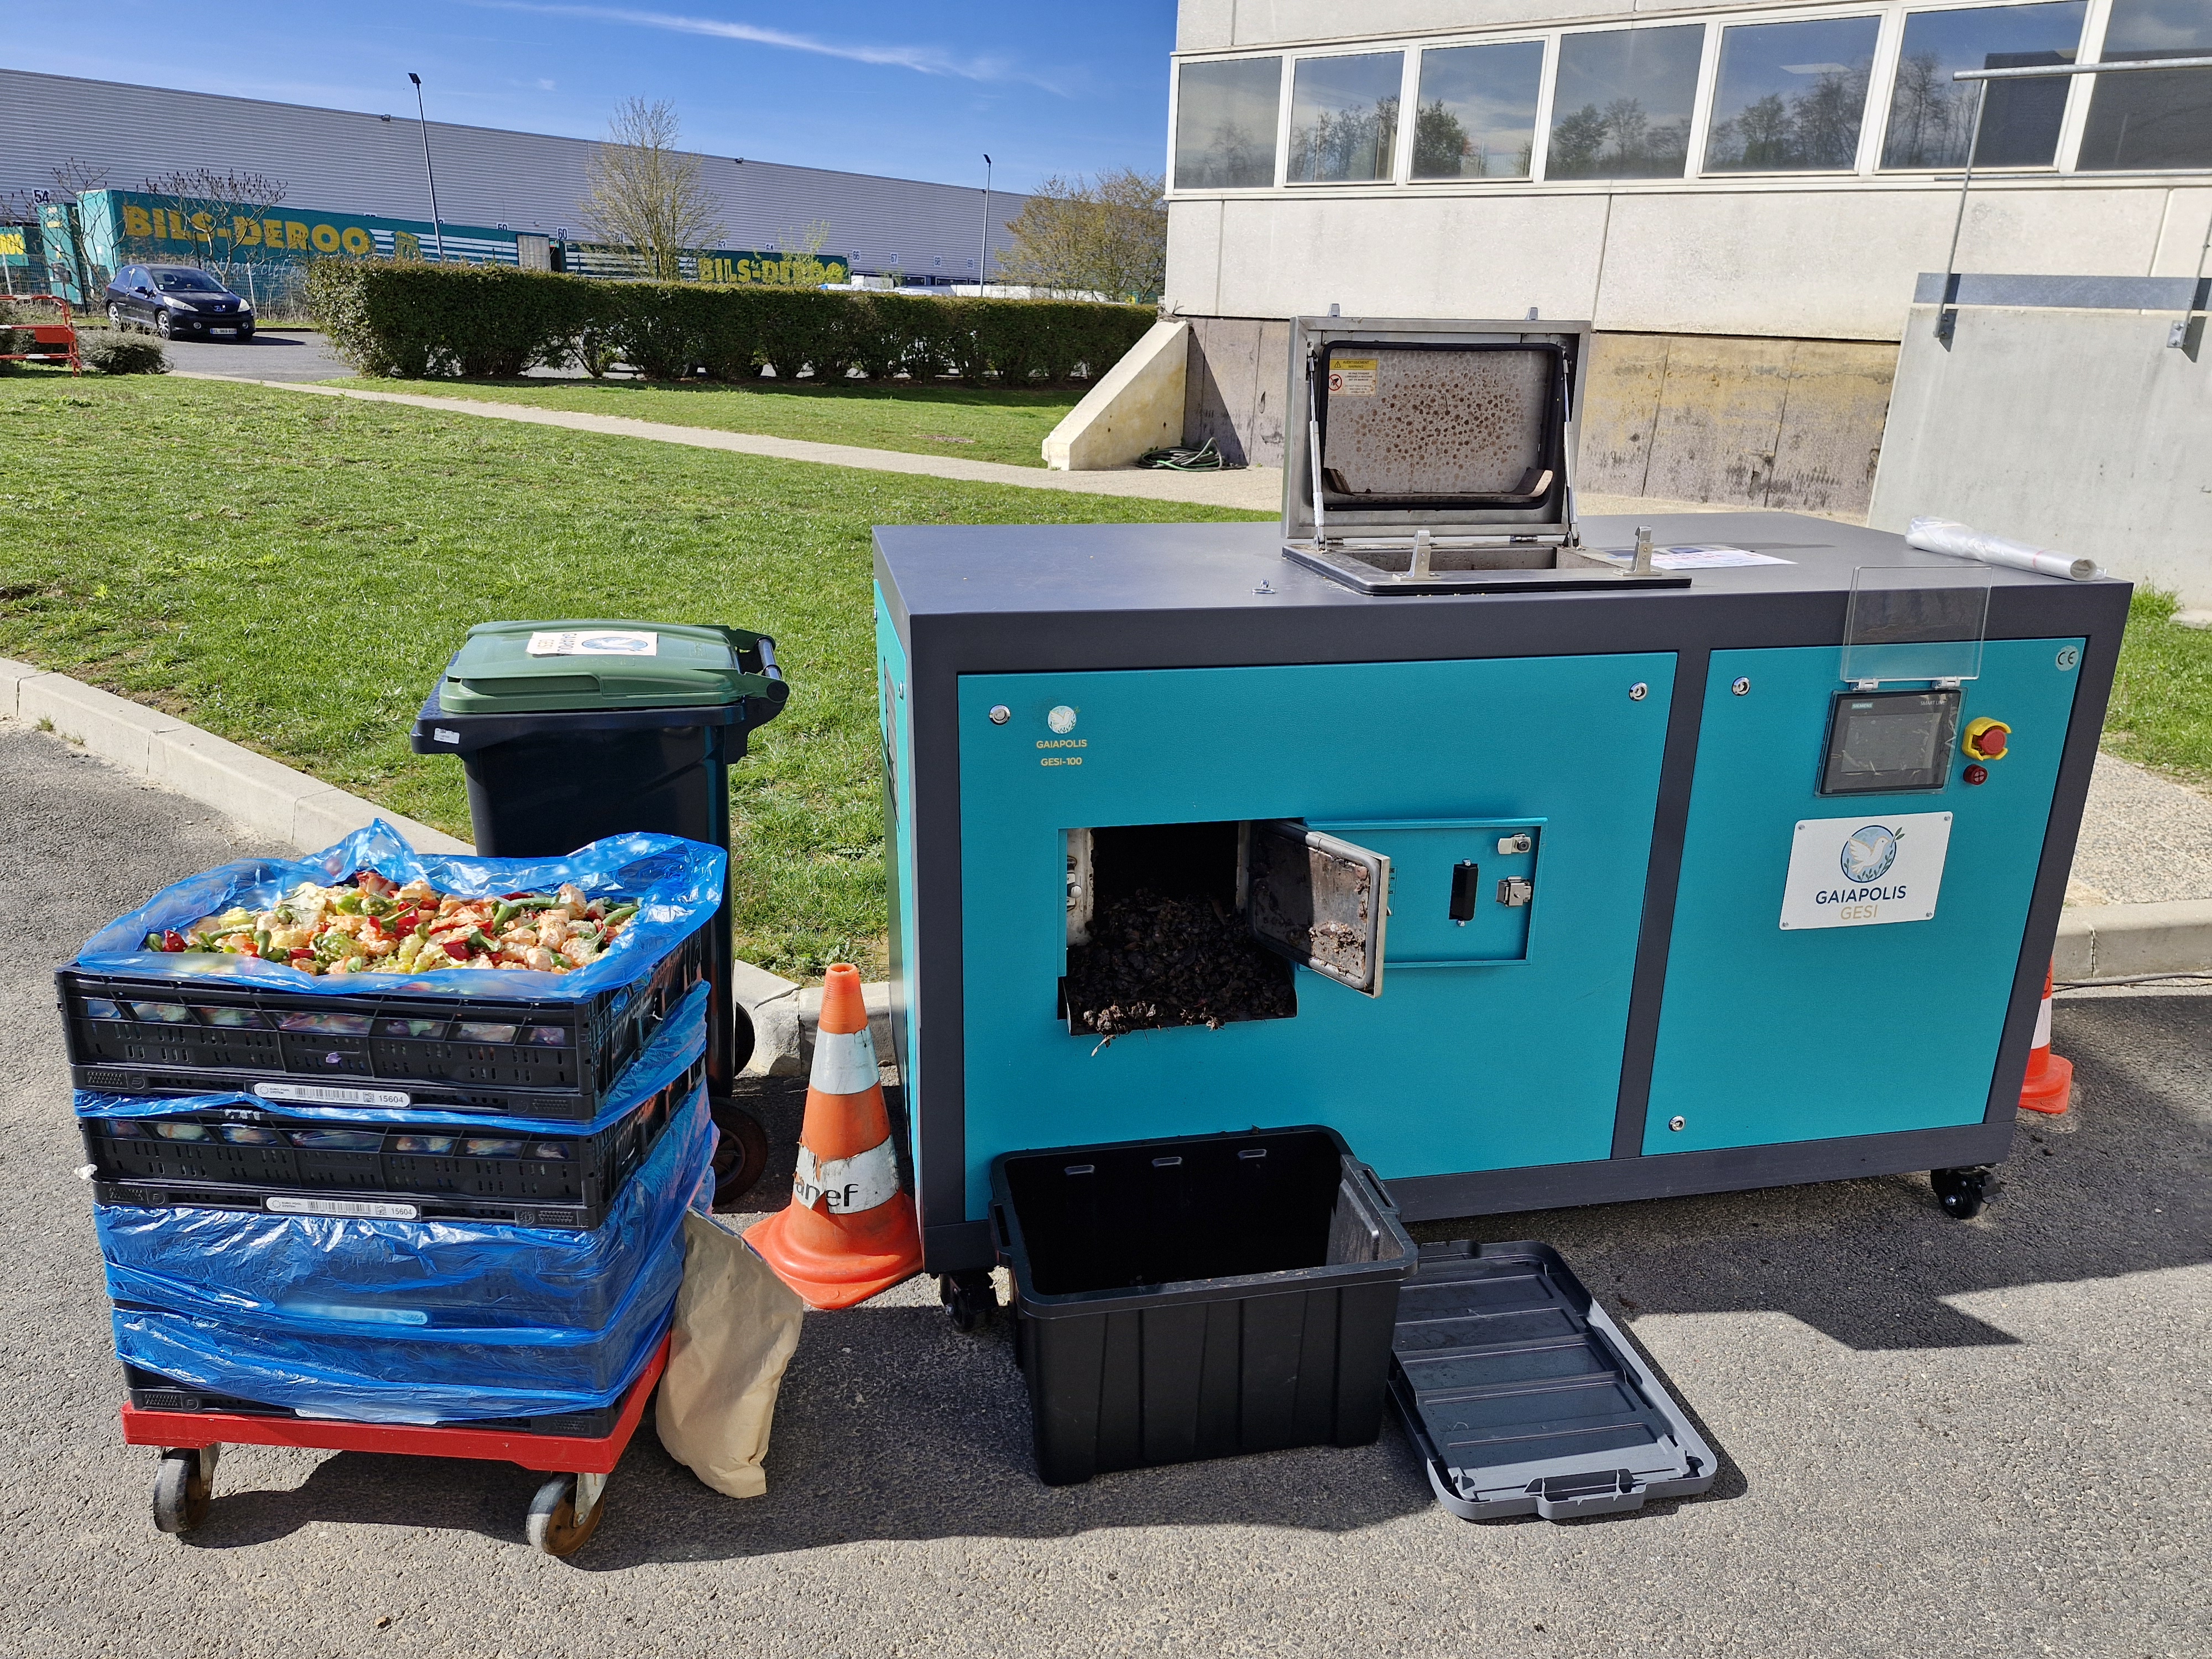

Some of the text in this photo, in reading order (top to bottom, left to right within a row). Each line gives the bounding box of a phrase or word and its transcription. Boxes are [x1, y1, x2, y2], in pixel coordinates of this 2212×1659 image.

[122, 206, 372, 254] BILS-DEROO
[557, 228, 567, 239] 60
[853, 251, 860, 260] 66
[891, 253, 898, 263] 67
[557, 633, 577, 654] GAIAPOLI
[1036, 739, 1088, 749] GAIAPOLIS
[1040, 757, 1082, 766] GESI-100
[1815, 885, 1907, 904] GAIAPOLIS
[1840, 905, 1878, 920] GESI
